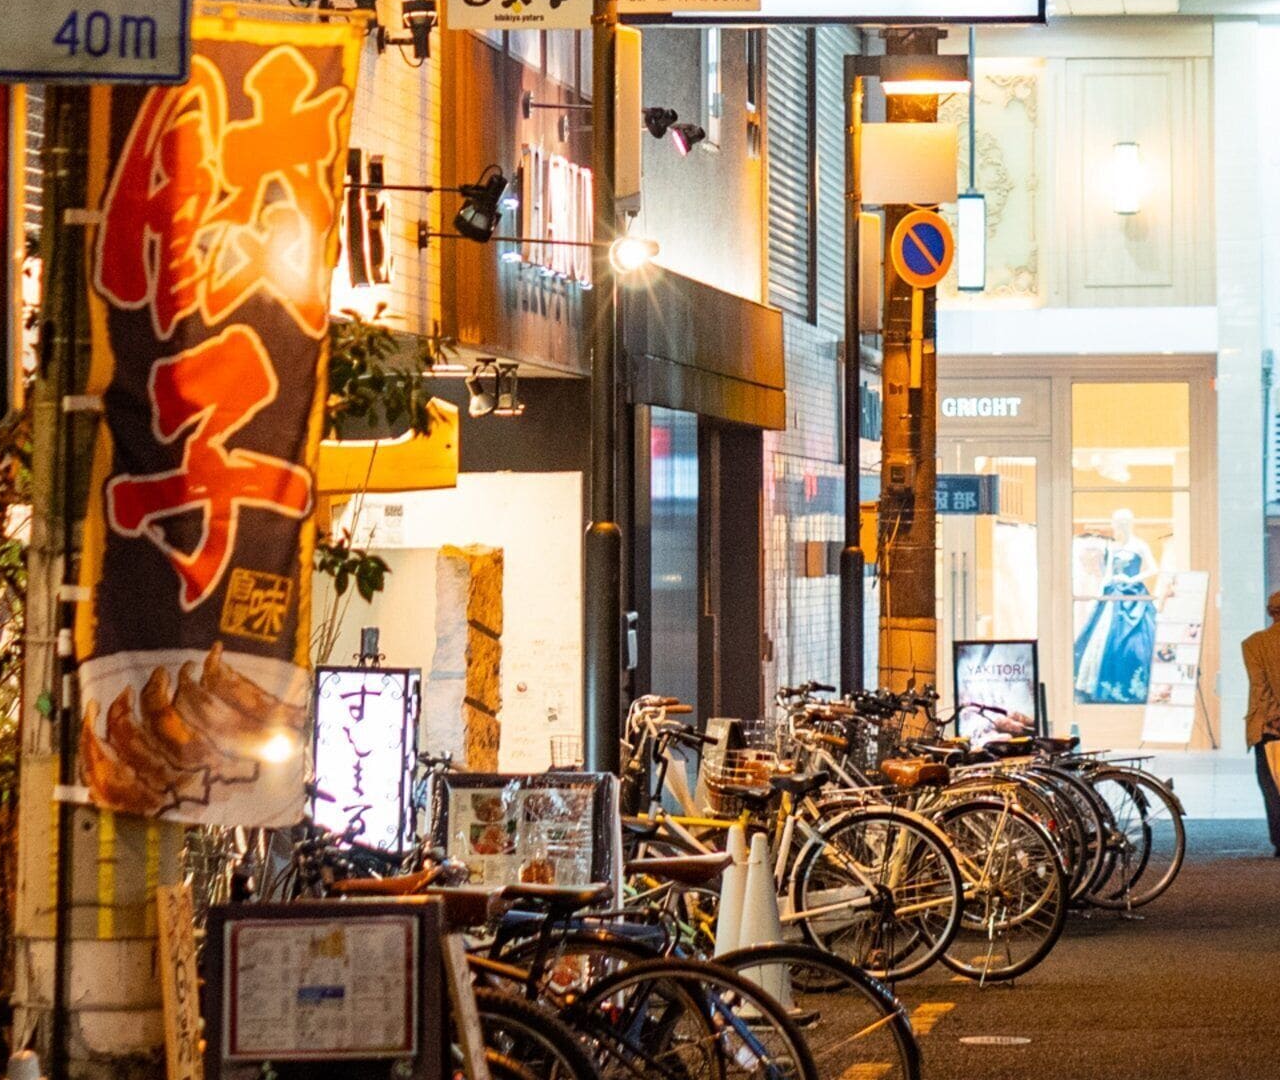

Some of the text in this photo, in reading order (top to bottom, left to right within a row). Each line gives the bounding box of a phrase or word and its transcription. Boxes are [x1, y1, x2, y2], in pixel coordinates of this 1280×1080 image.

[53, 10, 157, 60] 40m
[92, 42, 350, 612] 餃子
[967, 663, 1025, 676] YAKITORI
